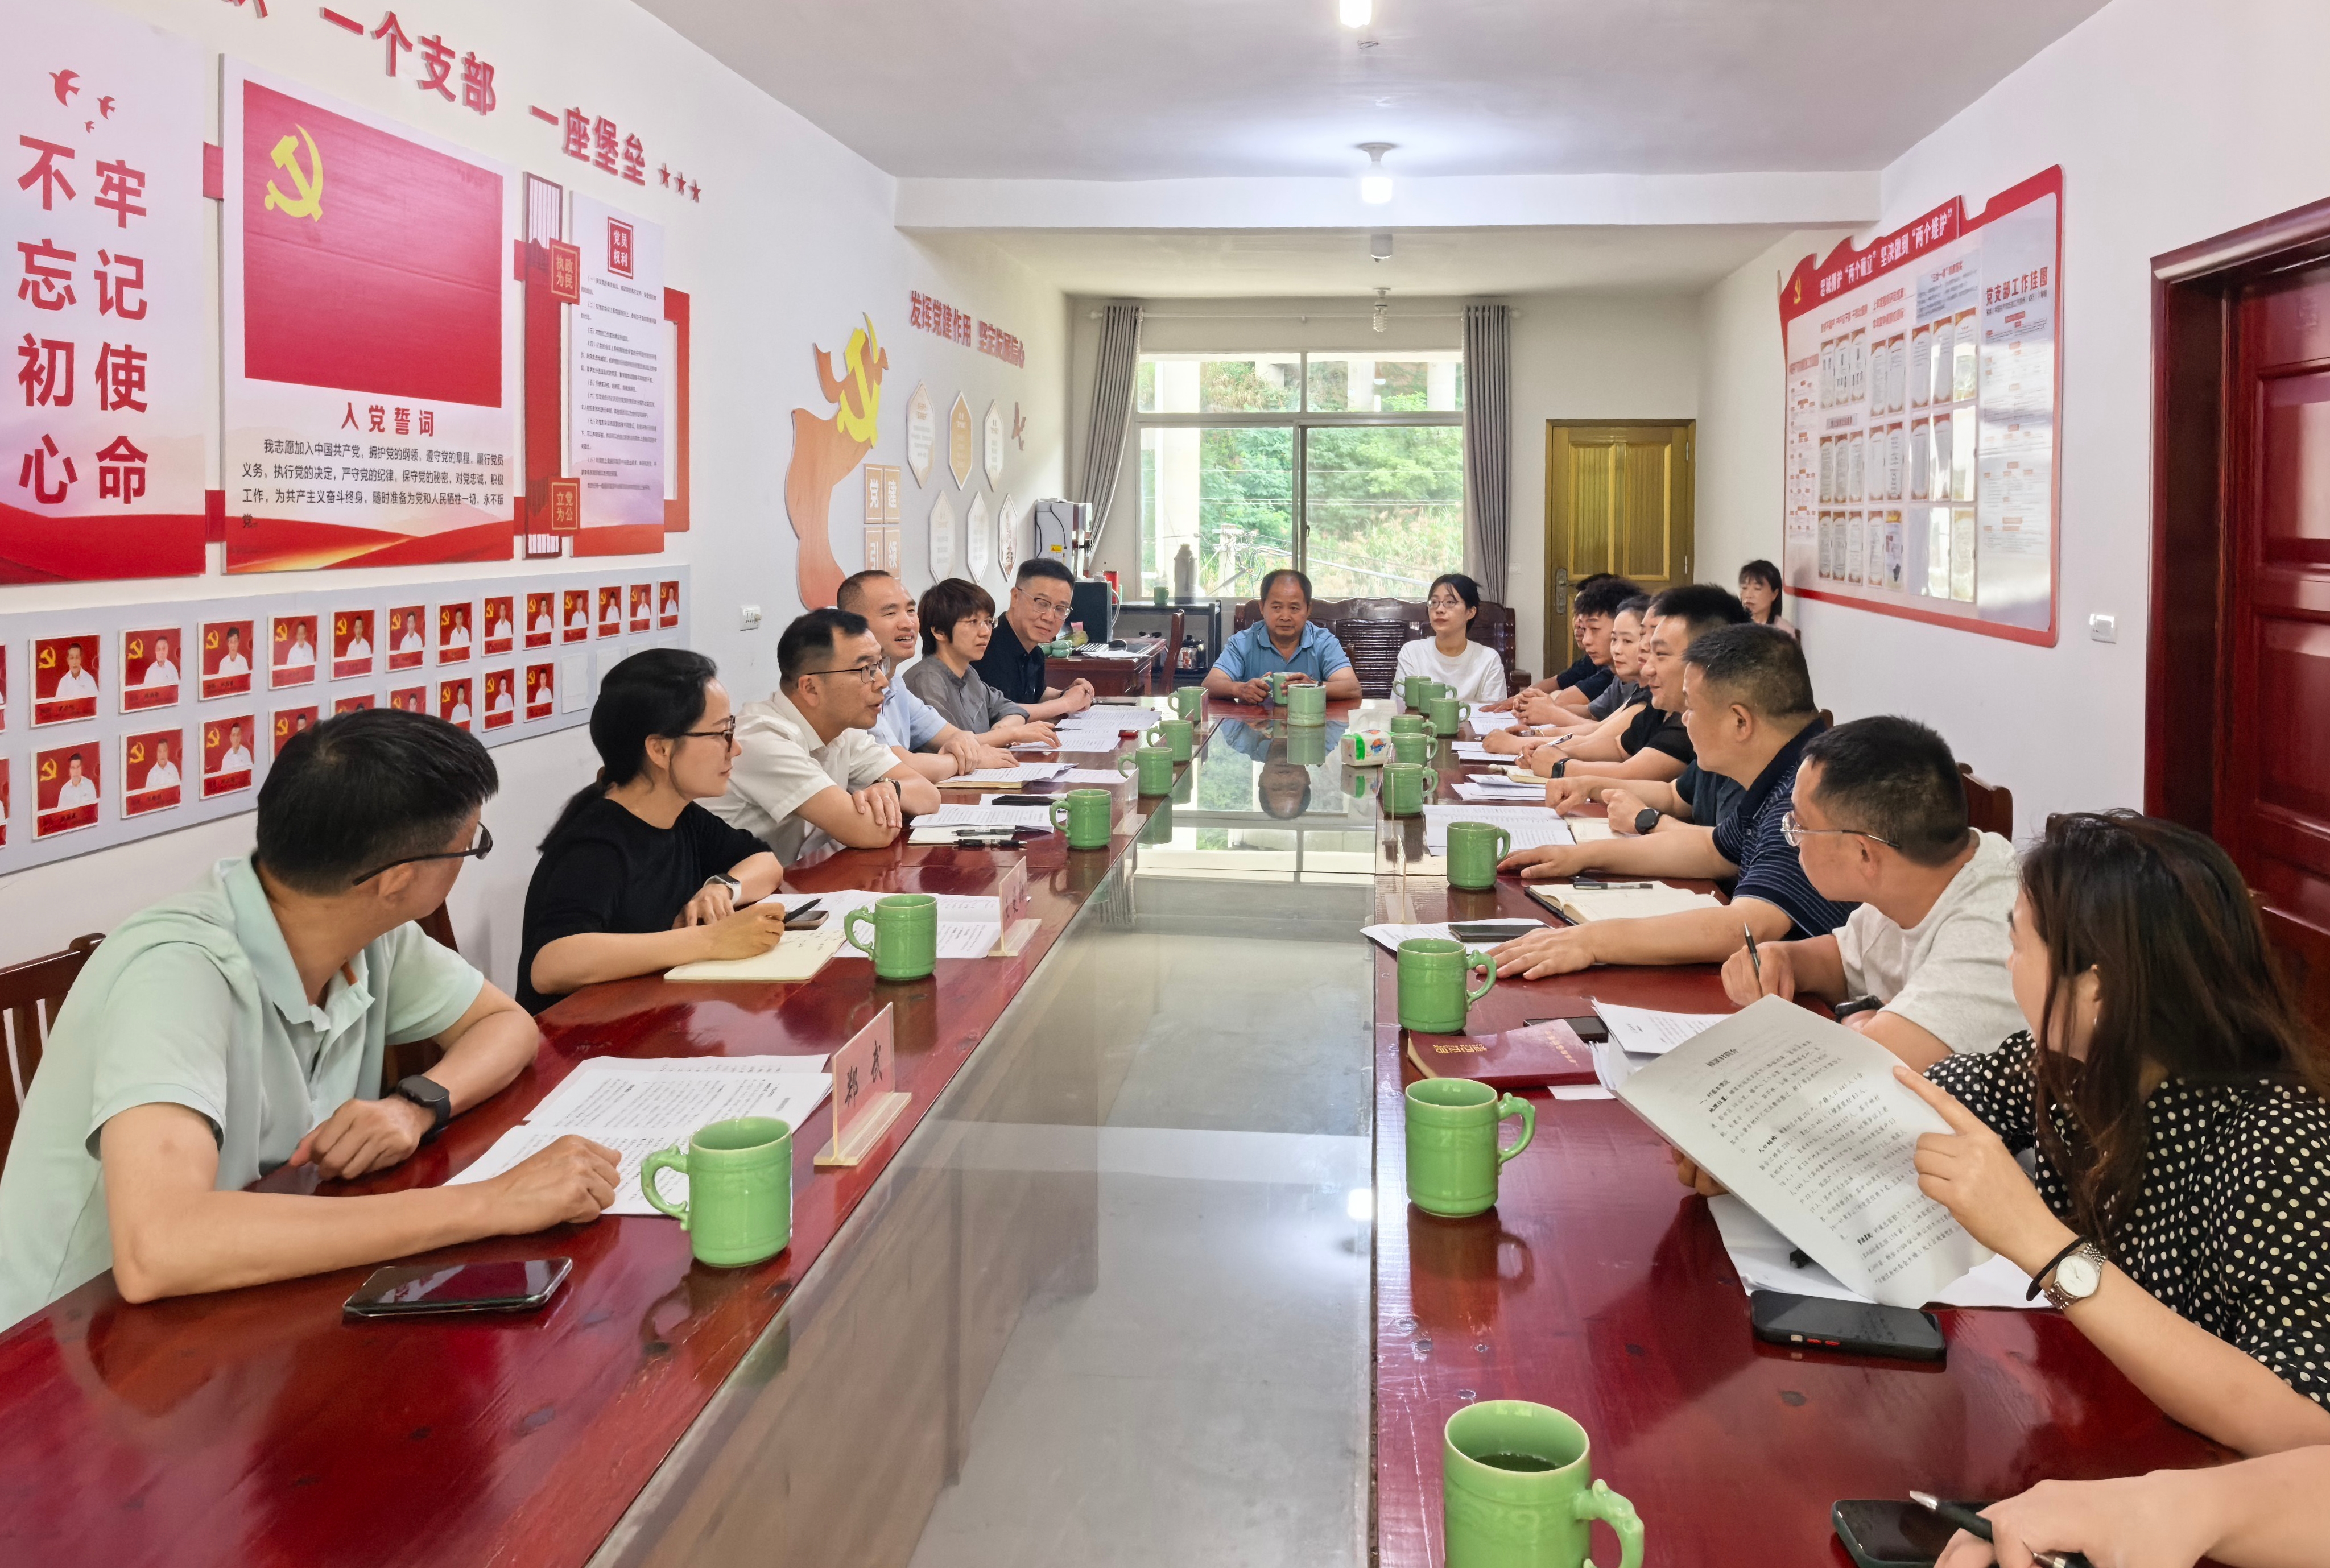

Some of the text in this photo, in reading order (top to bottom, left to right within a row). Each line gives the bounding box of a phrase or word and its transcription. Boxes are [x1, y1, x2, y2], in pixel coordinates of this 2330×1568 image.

[319, 7, 645, 186] 一个支部 一座堡垒
[613, 230, 627, 248] 党员
[613, 249, 628, 267] 权利
[556, 271, 573, 290] 为民
[17, 134, 78, 504] 不忘初心
[94, 159, 148, 504] 牢记使命
[910, 290, 971, 348] 发挥党建作用
[341, 402, 434, 437] 入党誓词
[870, 478, 897, 508] 党建
[870, 541, 898, 570] 引领
